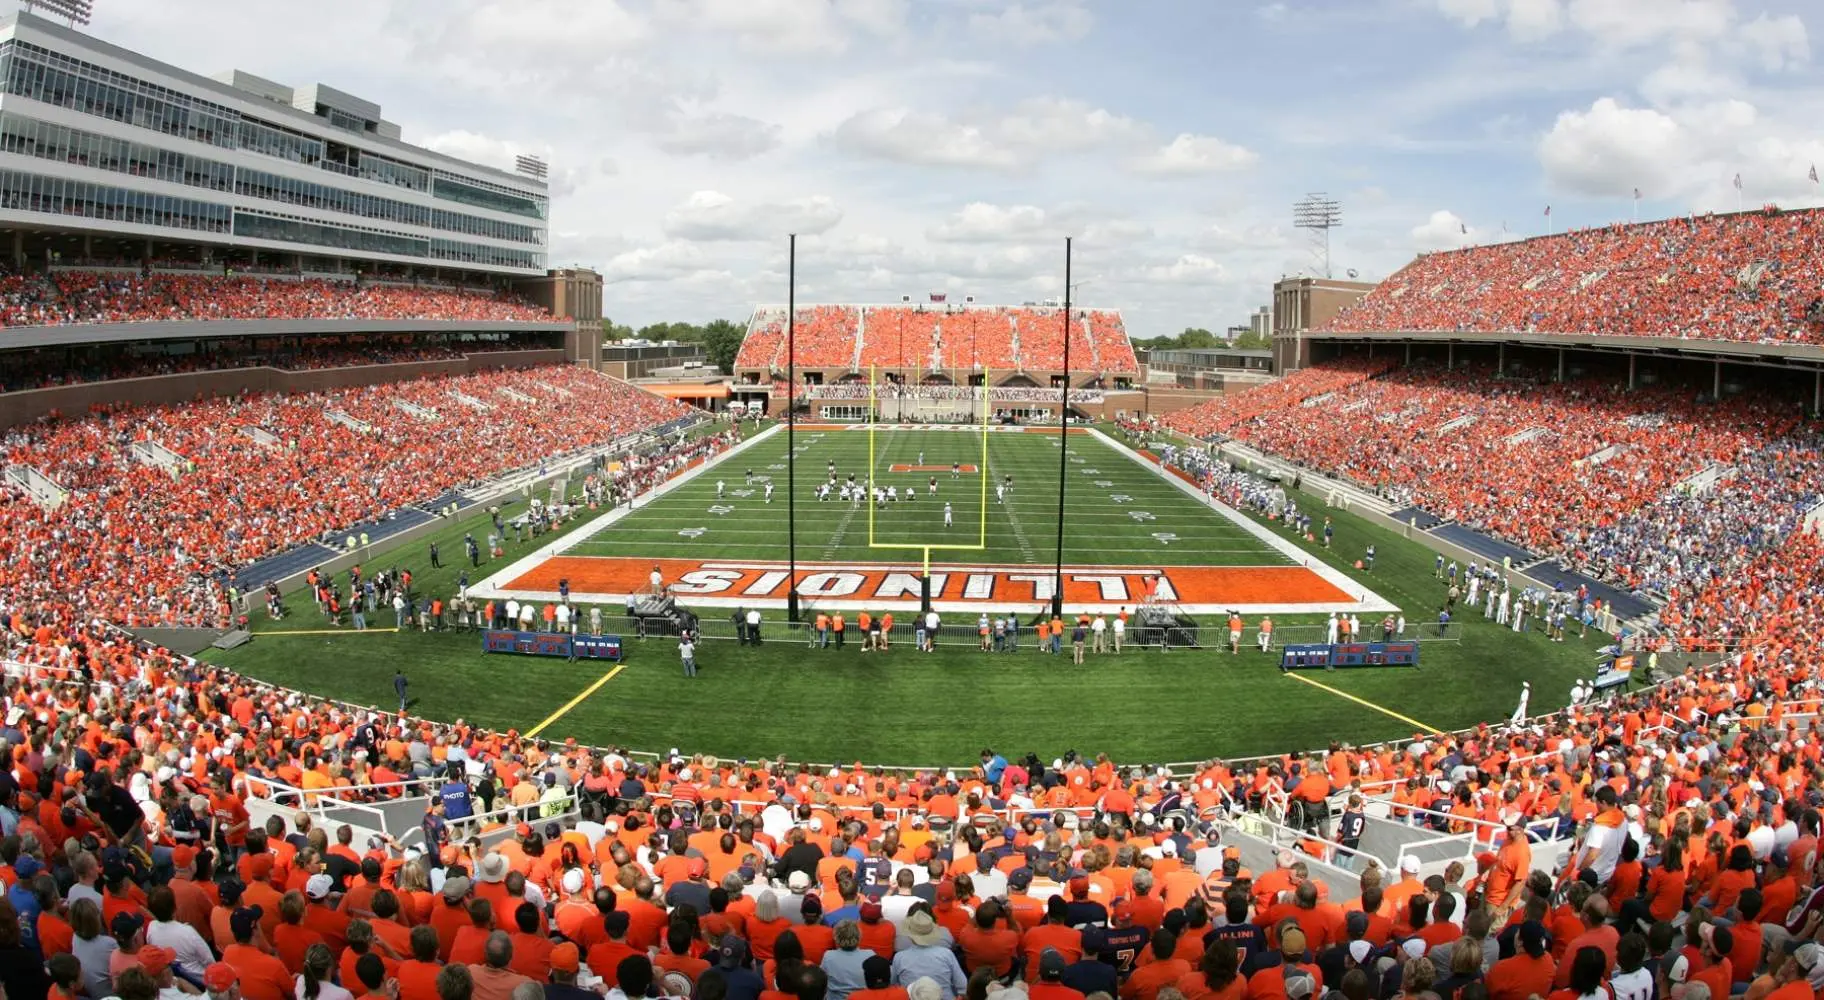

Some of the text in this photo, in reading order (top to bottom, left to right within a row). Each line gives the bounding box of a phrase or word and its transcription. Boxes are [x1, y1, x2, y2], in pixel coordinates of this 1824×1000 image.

[667, 569, 1180, 601] ILLINOIS
[443, 791, 465, 799] PHOTO
[1352, 817, 1363, 836] 9
[865, 867, 877, 885] 5
[1116, 948, 1135, 971] 7
